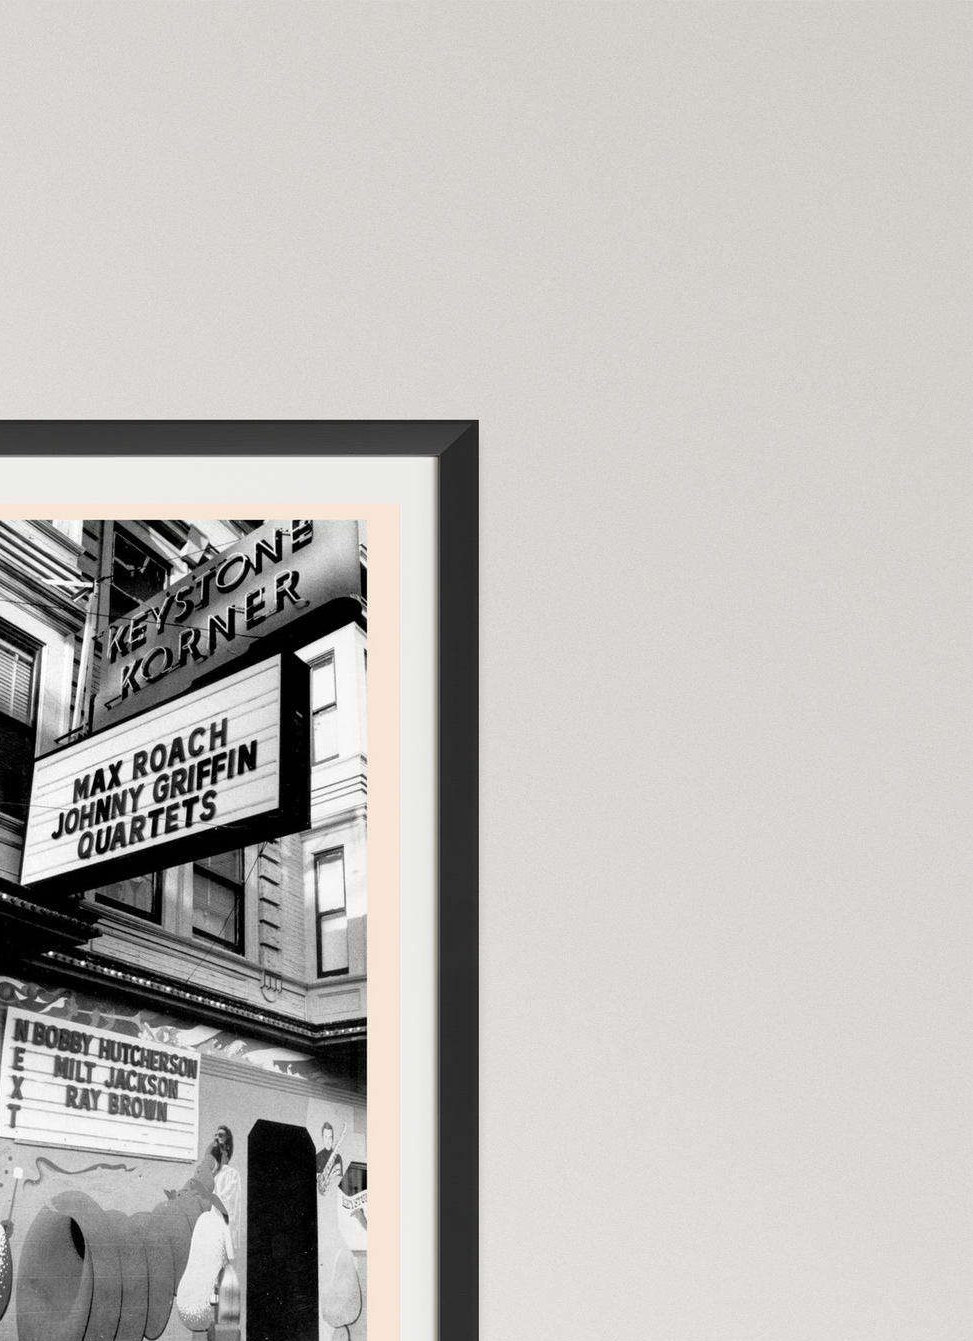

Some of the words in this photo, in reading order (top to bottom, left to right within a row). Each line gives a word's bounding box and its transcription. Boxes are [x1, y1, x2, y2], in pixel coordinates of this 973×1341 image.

[106, 520, 313, 664] KEYSTONE
[121, 569, 309, 700] KORNER
[51, 783, 145, 840] JOHNNY
[152, 739, 258, 804] GRIFFIN
[73, 761, 123, 804] MAX
[132, 717, 228, 781] ROACH
[77, 789, 217, 860] QUARTETS
[7, 1018, 30, 1129] NEXT
[32, 1021, 94, 1056] BOBBY
[98, 1037, 198, 1080] HUTCHERSON
[53, 1055, 96, 1084] MILT
[104, 1066, 179, 1100] JACKSON
[65, 1084, 102, 1111] RAY
[107, 1092, 168, 1123] BROWN
